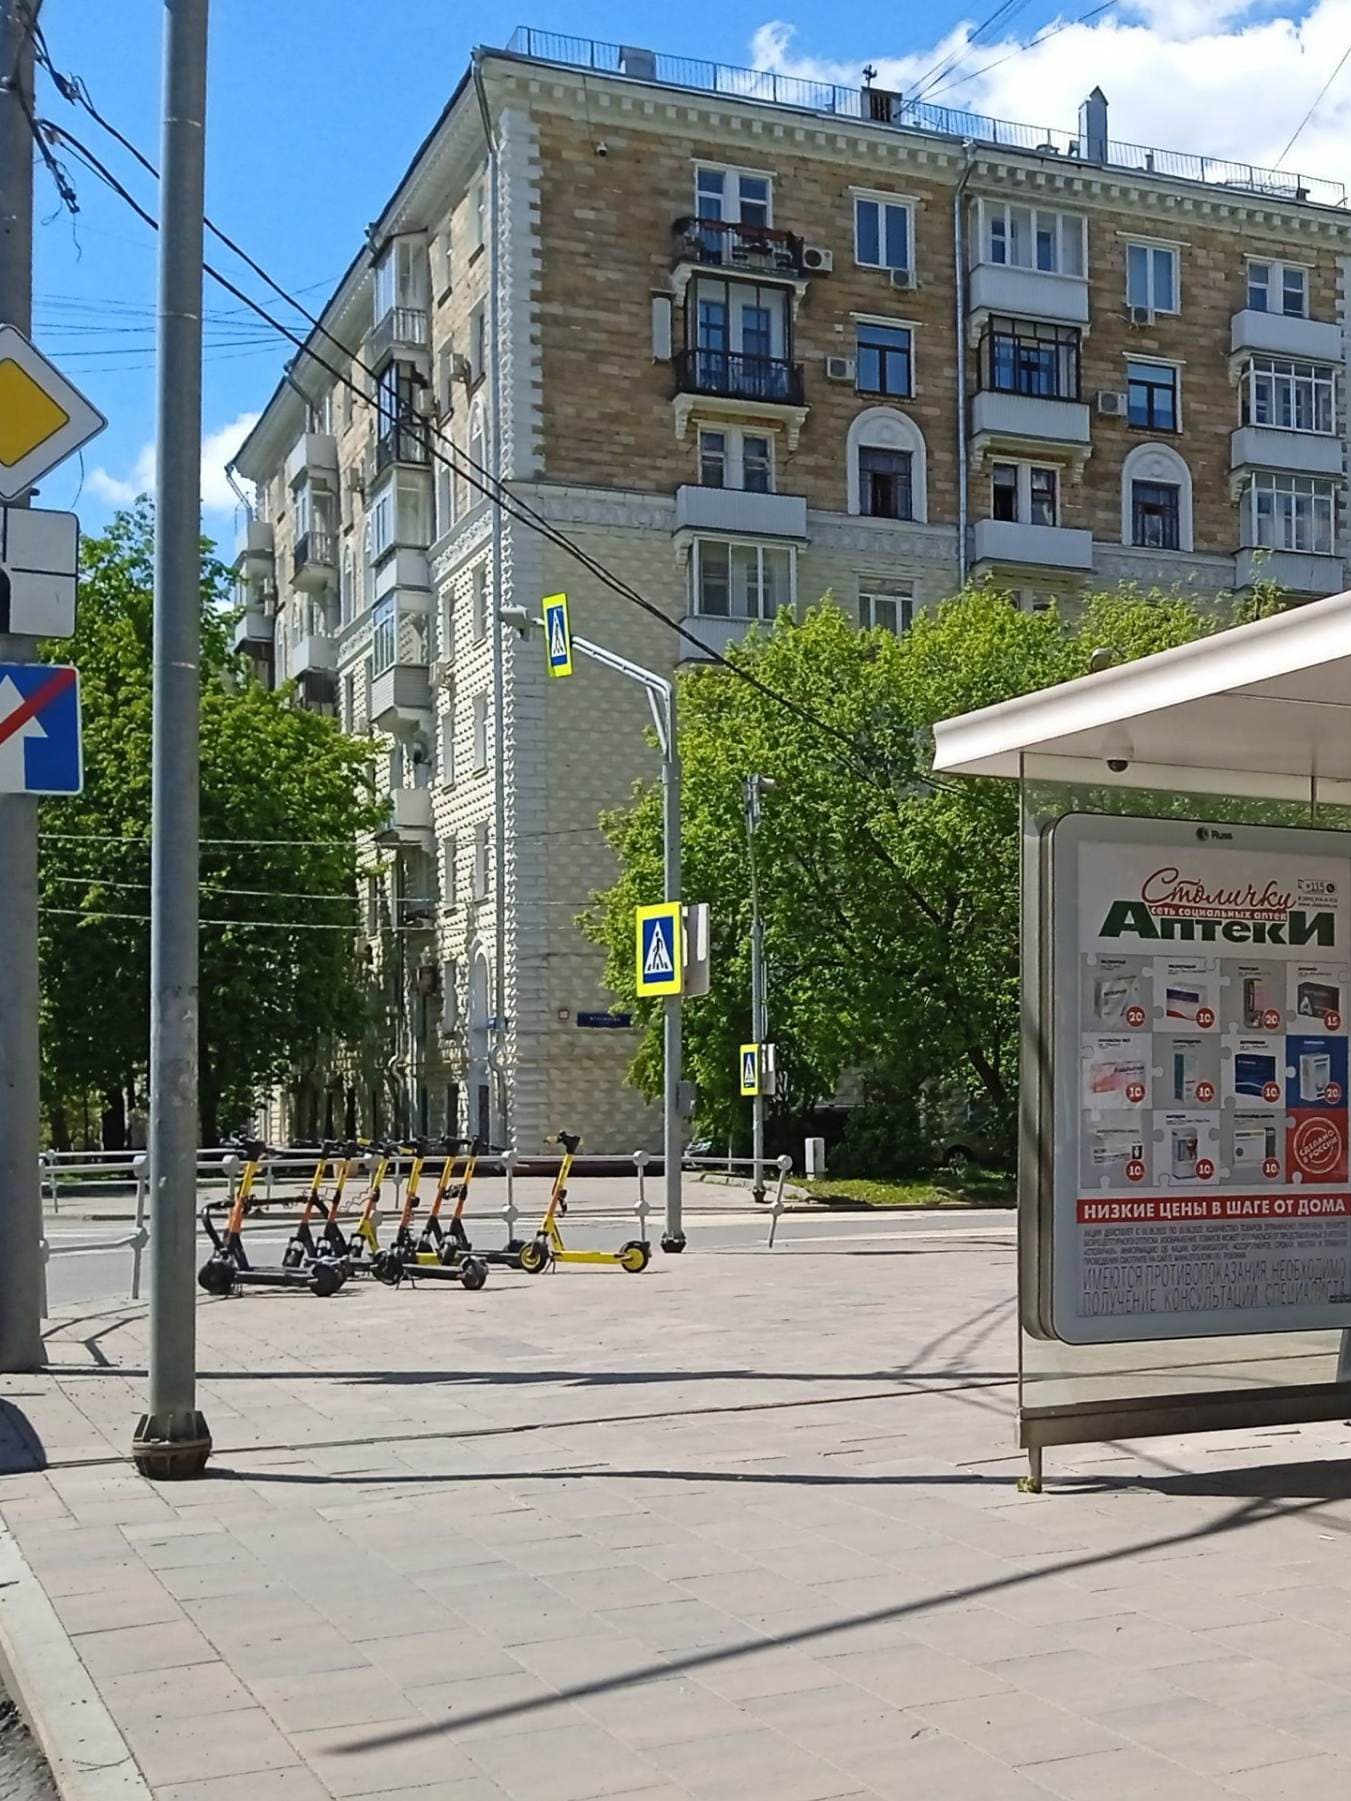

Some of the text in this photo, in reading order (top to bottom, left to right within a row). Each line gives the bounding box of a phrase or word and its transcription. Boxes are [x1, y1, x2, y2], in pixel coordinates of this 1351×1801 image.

[1141, 867, 1297, 910] Столички
[1151, 905, 1288, 922] сеть социальных аптек
[1084, 1198, 1345, 1219] НИЗКИЕ ЦЕНЫ В ШАГЕ ОТ ДОМА
[1084, 1265, 1142, 1290] ИМЕЮТСЯ
[1083, 1288, 1157, 1315] ПОЛУЧЕНИЕ
[1164, 1284, 1258, 1311] КОНСУЛЬТАЦИИ
